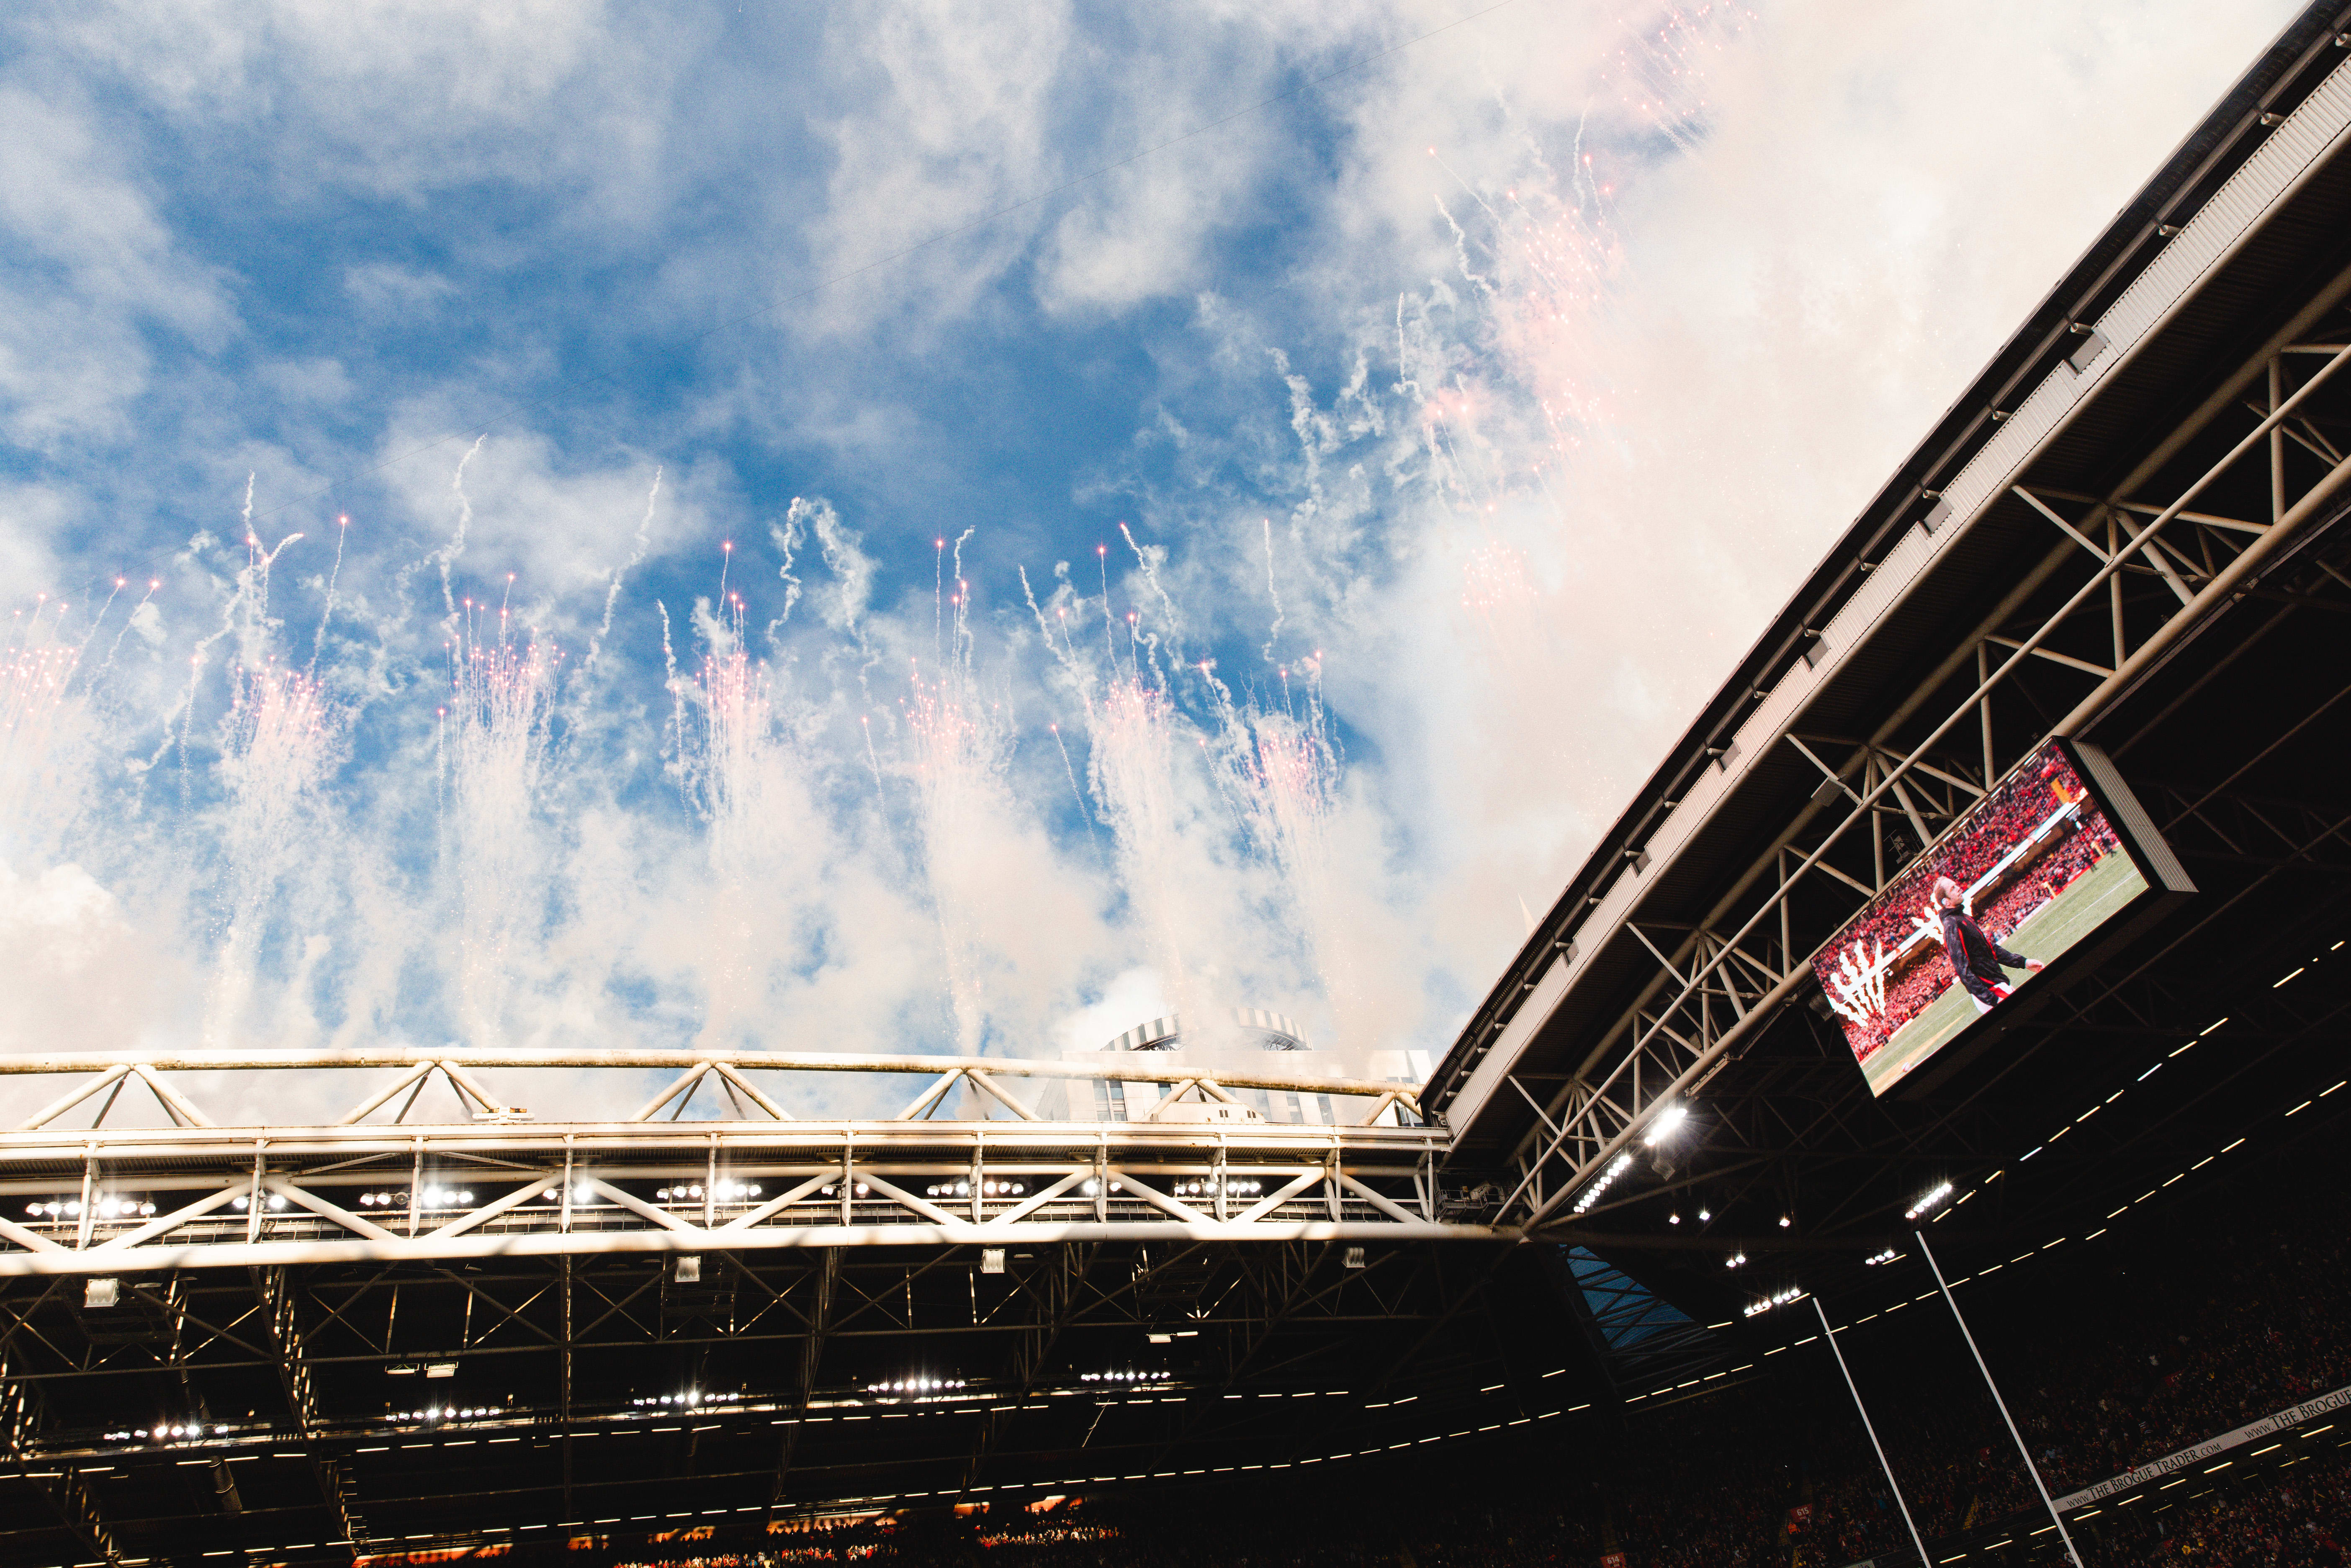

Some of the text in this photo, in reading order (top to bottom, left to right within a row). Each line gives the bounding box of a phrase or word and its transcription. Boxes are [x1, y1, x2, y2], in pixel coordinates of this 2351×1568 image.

[2109, 1467, 2154, 1491] BROGUE
[1796, 1506, 1809, 1516] 615
[1607, 1555, 1620, 1564] 614
